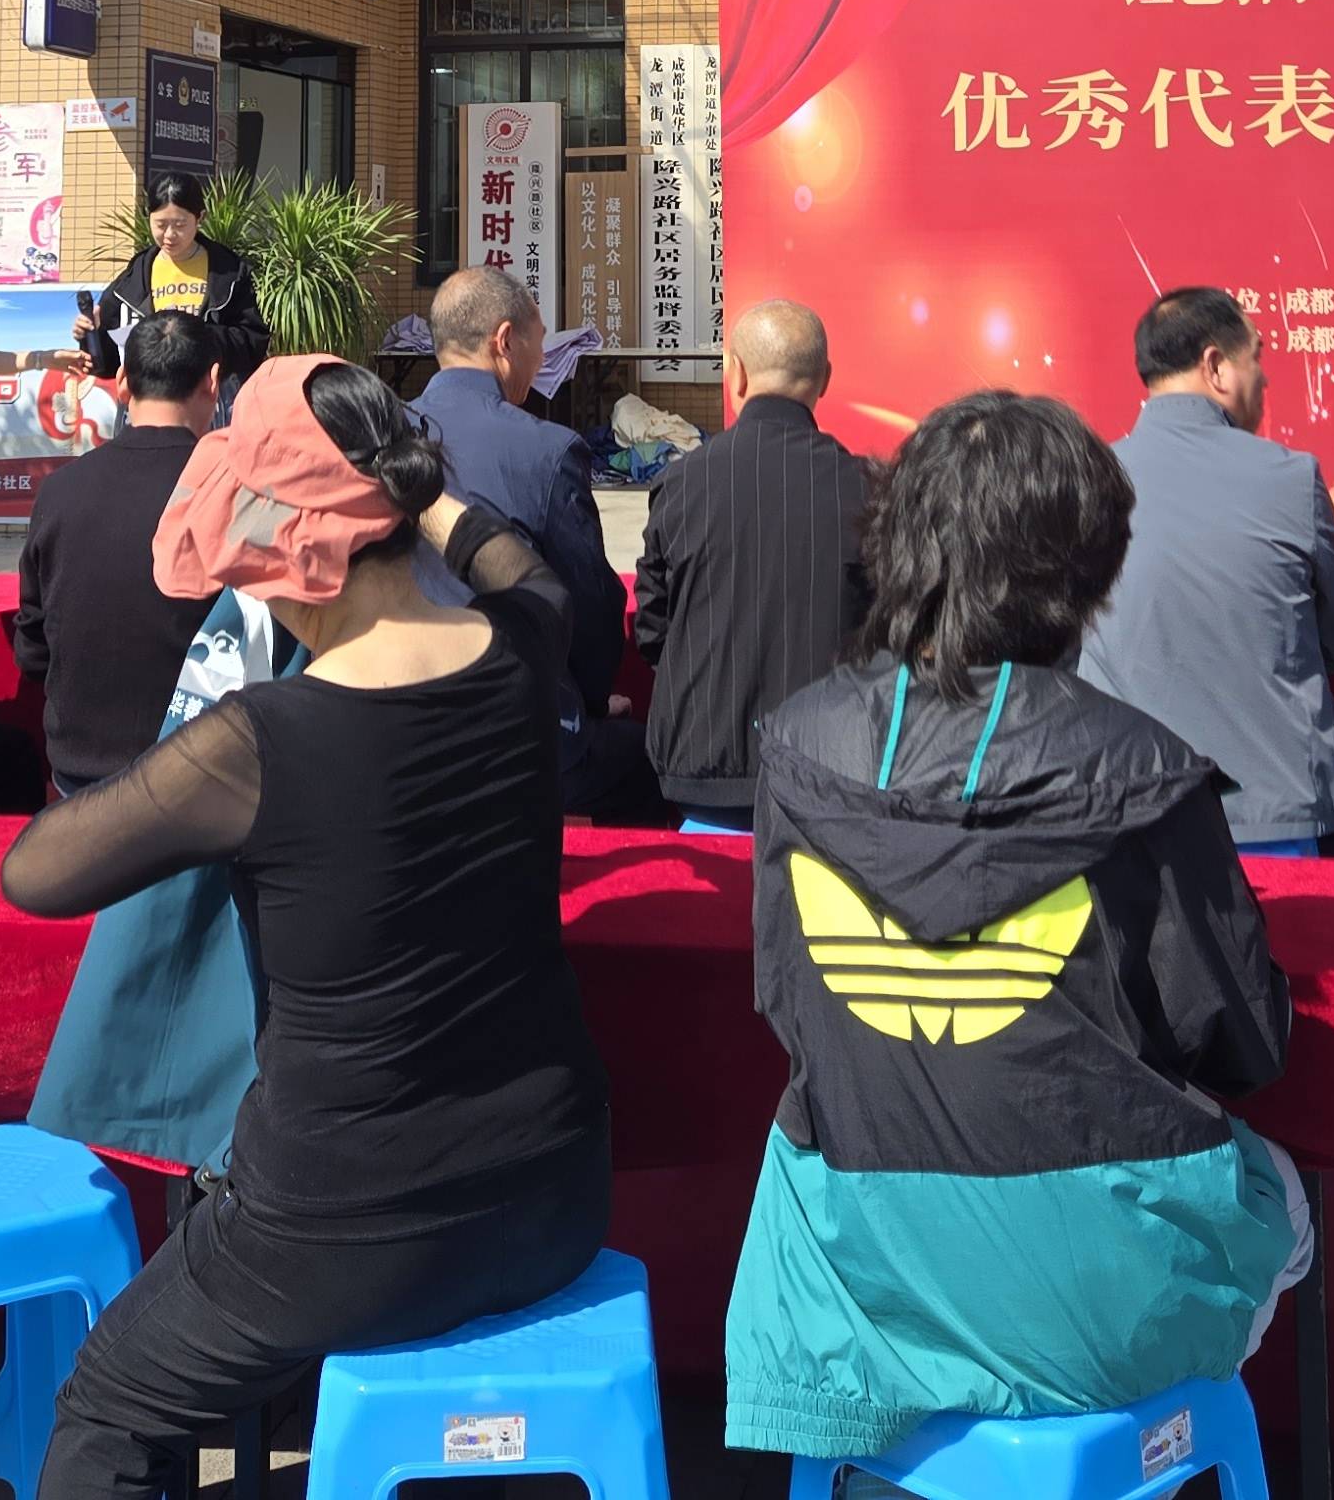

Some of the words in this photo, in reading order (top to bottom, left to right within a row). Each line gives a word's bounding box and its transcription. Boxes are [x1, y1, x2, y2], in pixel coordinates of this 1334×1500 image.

[158, 82, 172, 97] 公安
[192, 88, 210, 105] POLICE
[650, 58, 663, 146] 龙潭街道
[671, 57, 685, 146] 成都市成华区
[581, 182, 596, 250] 以文化人
[605, 198, 621, 266] 凝聚群众
[606, 280, 621, 349] 引导群众
